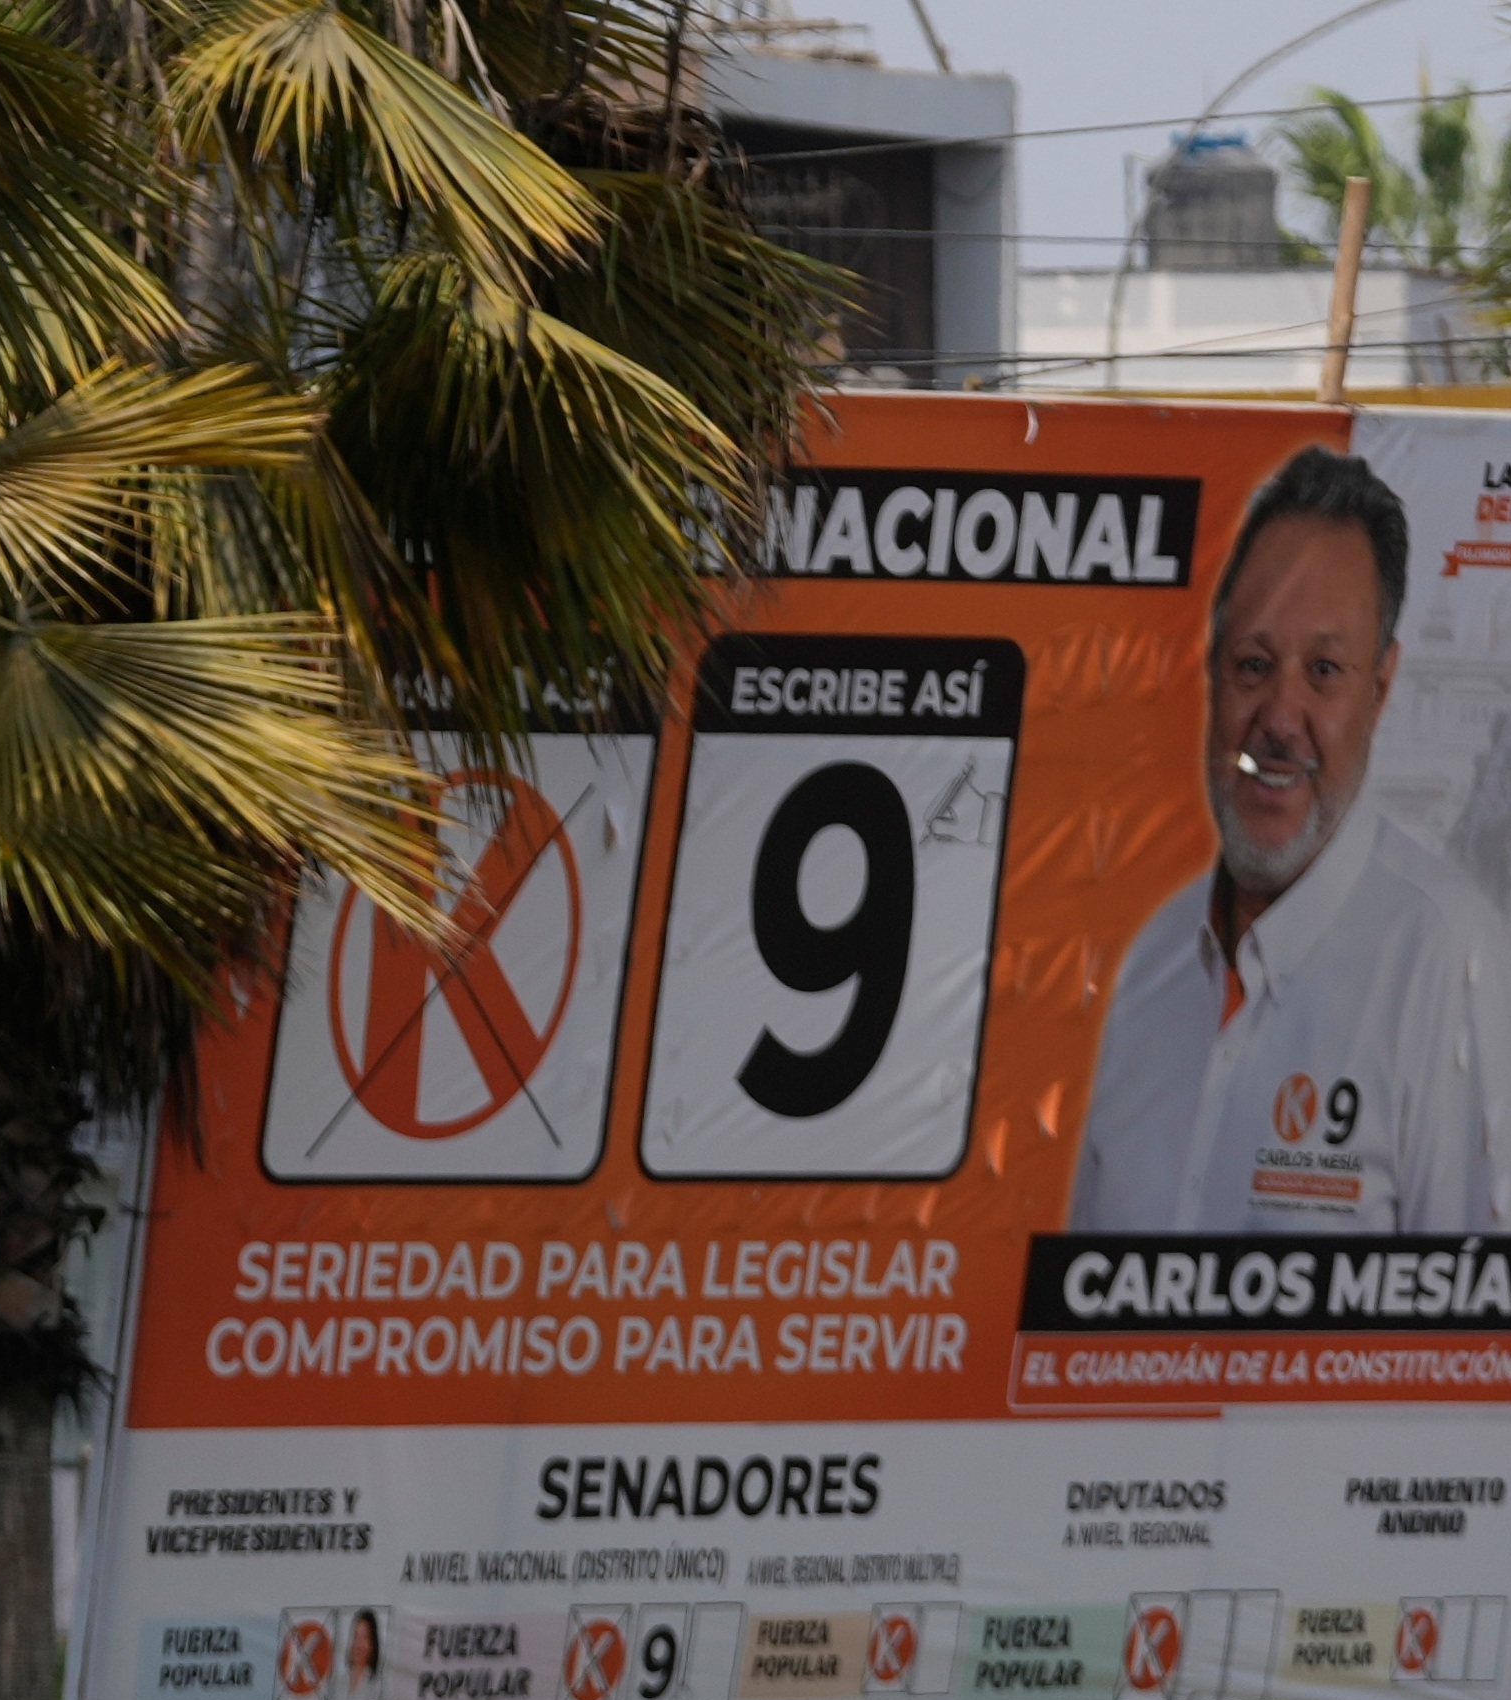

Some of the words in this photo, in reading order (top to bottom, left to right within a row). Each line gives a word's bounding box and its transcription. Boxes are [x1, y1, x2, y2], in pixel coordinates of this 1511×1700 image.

[759, 485, 1181, 582] NACIONAL
[731, 666, 905, 717] ESCRIBE
[911, 659, 988, 718] ASÍ
[734, 760, 916, 1118] 9
[1323, 1076, 1361, 1146] 9
[1255, 1146, 1314, 1167] CARLOS
[234, 1240, 524, 1303] SERIEDAD
[536, 1240, 687, 1300] PARA
[701, 1239, 959, 1298] LEGISLAR
[1063, 1250, 1318, 1318] CARLOS
[205, 1315, 603, 1378] COMPROMISO
[614, 1314, 762, 1374] PARA
[775, 1312, 969, 1374] SERVIR
[1022, 1350, 1061, 1386] EL
[1066, 1342, 1219, 1386] GUARDIÁN
[1224, 1350, 1266, 1386] DE
[1271, 1350, 1307, 1385] LA
[167, 1488, 335, 1516] PRESIDENTES
[342, 1487, 360, 1515] Y
[535, 1453, 881, 1521] SENADORES
[1066, 1480, 1229, 1513] DIPUTADOS
[1345, 1476, 1507, 1505] PARLAMENTO
[1077, 1521, 1124, 1547] NIVEL
[1127, 1521, 1213, 1549] REGIONAL
[1376, 1508, 1468, 1536] ANDINO
[146, 1523, 373, 1555] VICEPRESIDENTES
[418, 1551, 470, 1584] NIVEL
[477, 1550, 567, 1583] NACIONAL
[572, 1547, 660, 1587] (DISTRITO
[757, 1619, 831, 1646] FUERZA
[982, 1614, 1072, 1650] FUERZA
[1297, 1608, 1365, 1635] FUERZA
[162, 1626, 242, 1655] FUERZA
[423, 1623, 520, 1661] FUERZA
[1292, 1641, 1376, 1667] POPULAR
[158, 1661, 254, 1689] POPULAR
[638, 1622, 679, 1700] 9
[751, 1653, 840, 1679] POPULAR
[974, 1658, 1086, 1690] POPULAR
[417, 1667, 532, 1698] POPULAR
